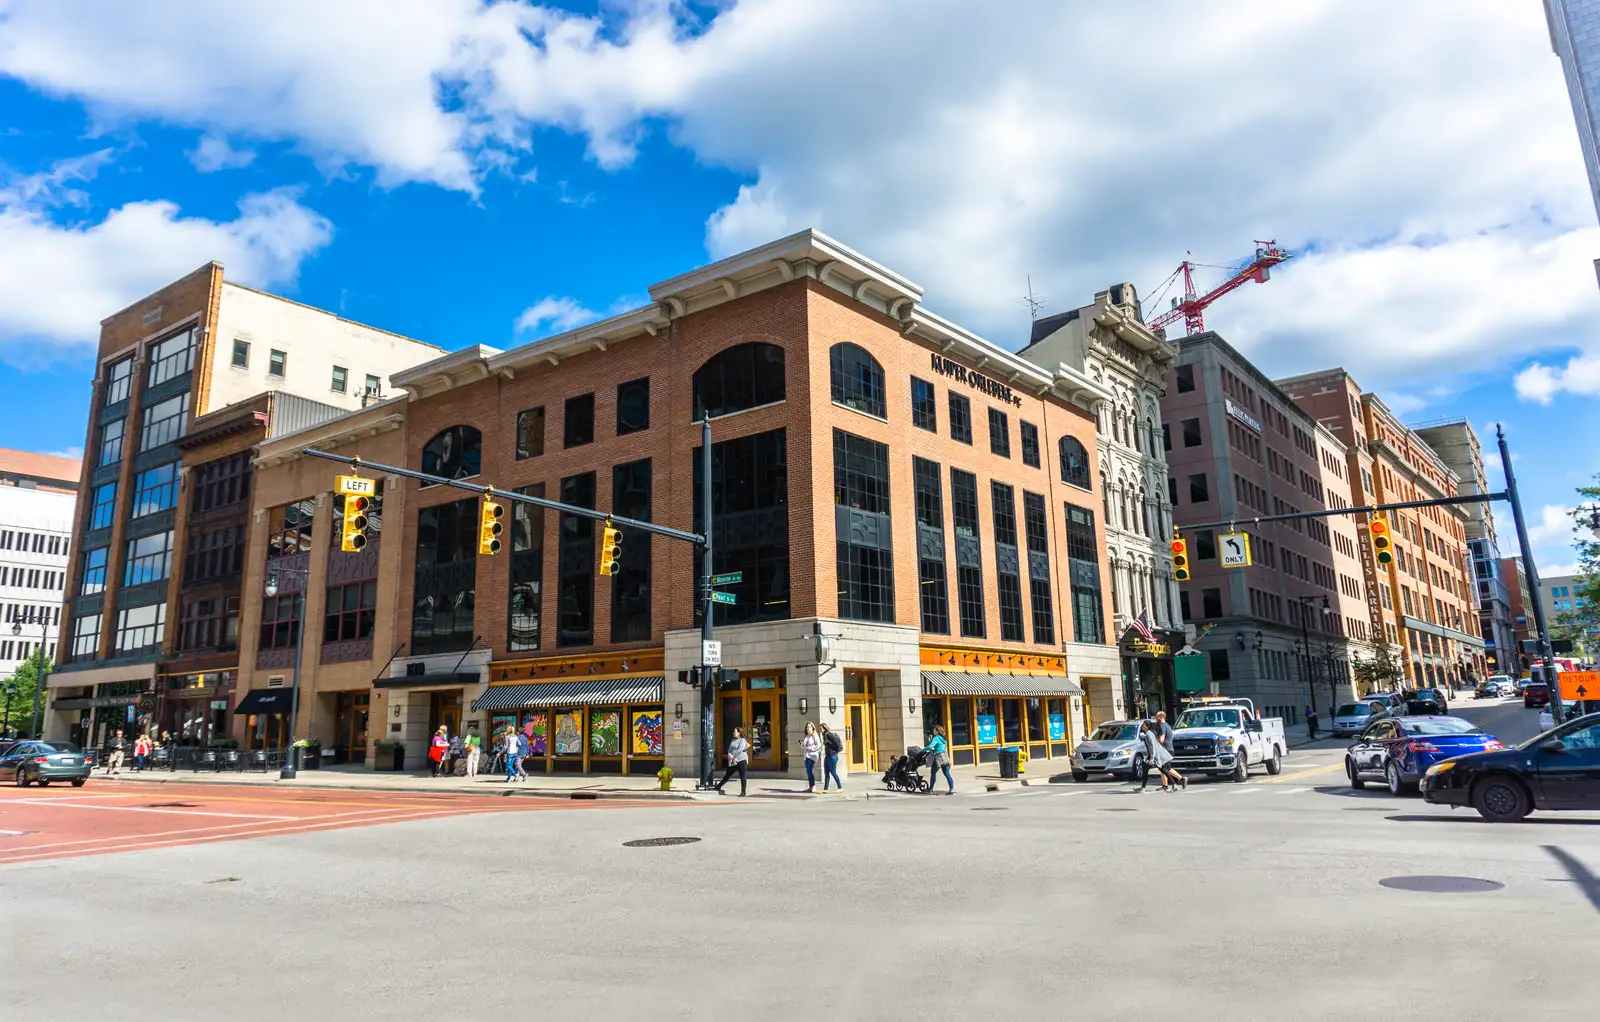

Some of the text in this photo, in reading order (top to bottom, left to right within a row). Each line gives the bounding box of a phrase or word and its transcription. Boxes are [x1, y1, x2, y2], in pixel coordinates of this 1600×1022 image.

[931, 353, 967, 385] KUIPER
[346, 480, 369, 491] LEFT
[1225, 555, 1244, 563] ONLY
[1360, 535, 1373, 576] ELLIS
[1367, 581, 1382, 639] PARKING
[1562, 674, 1597, 683] DETOUR
